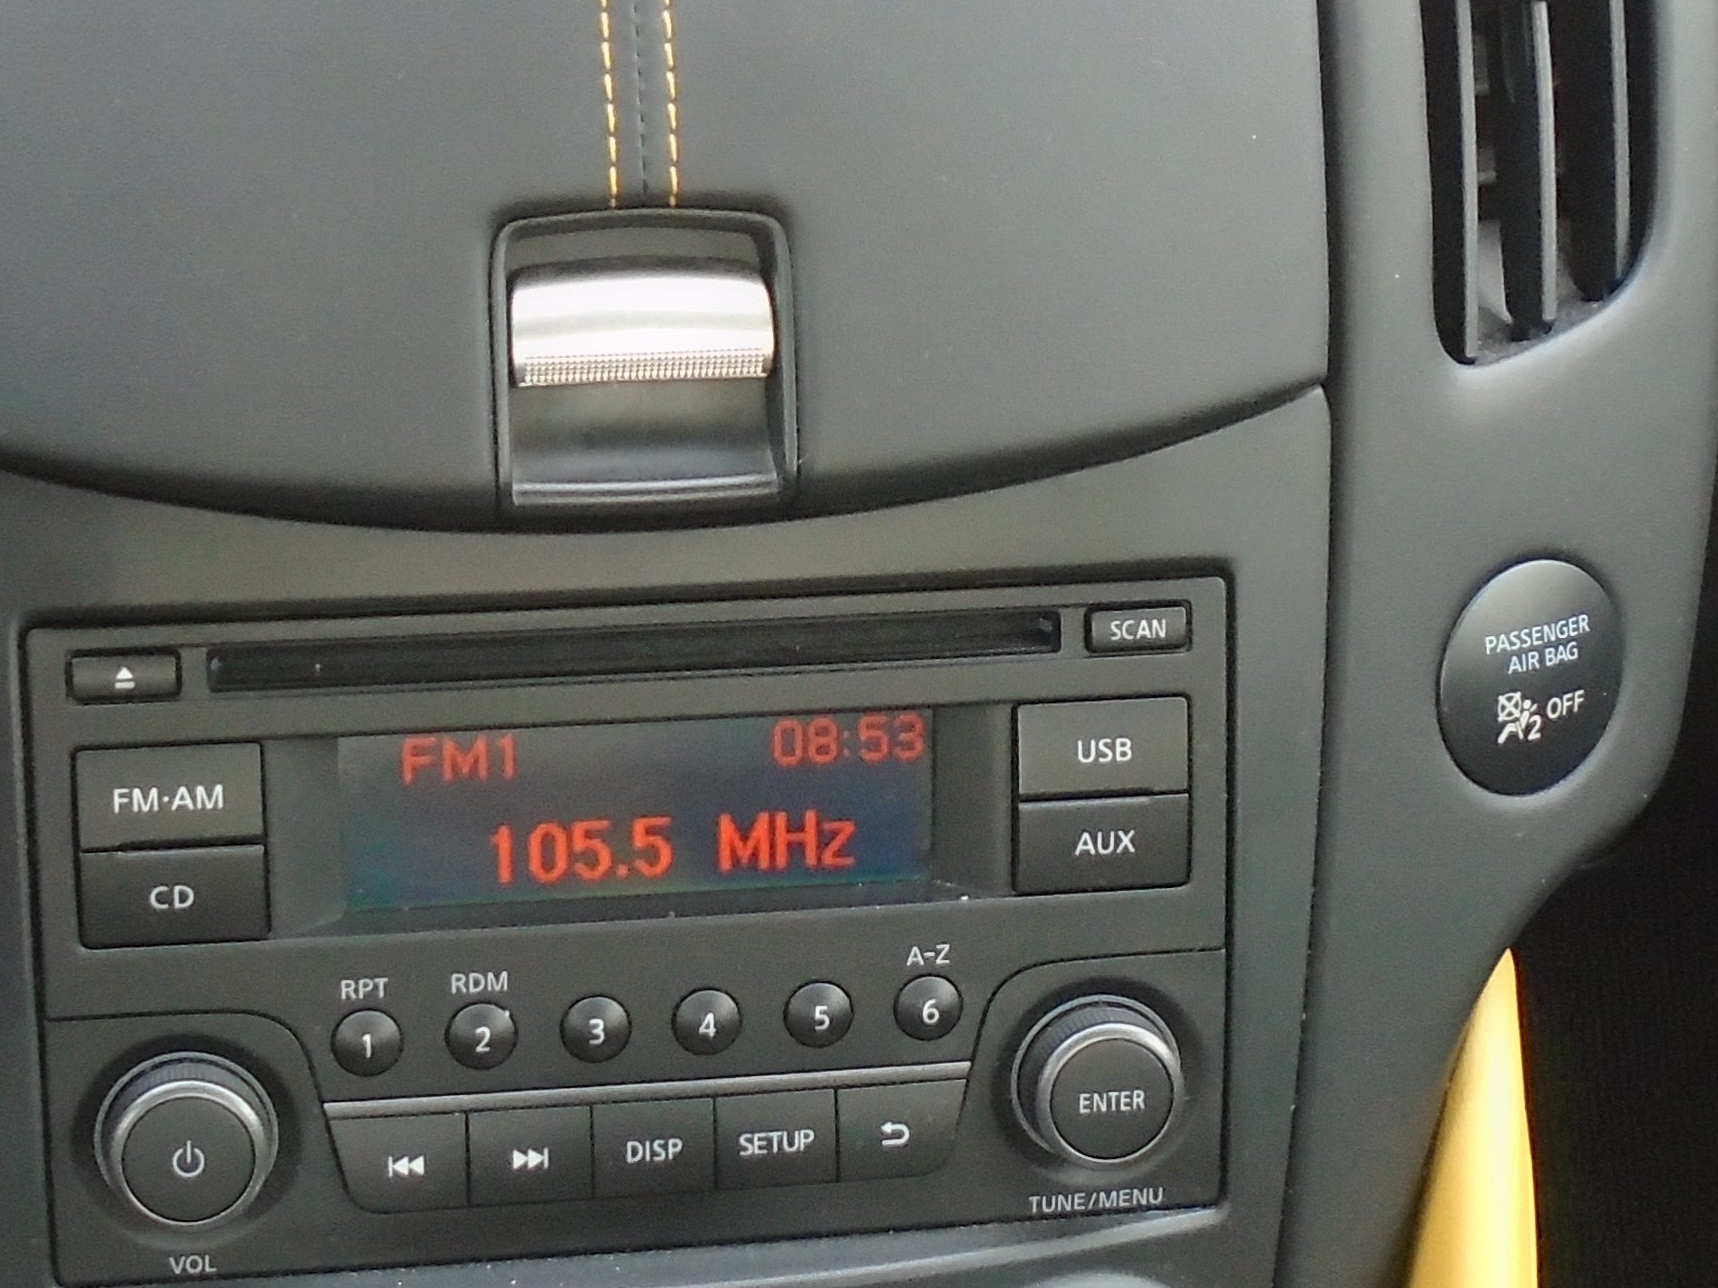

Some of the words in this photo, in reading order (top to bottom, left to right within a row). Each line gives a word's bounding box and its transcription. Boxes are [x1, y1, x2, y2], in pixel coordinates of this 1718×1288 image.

[1110, 618, 1167, 641] SCAN
[1485, 614, 1590, 654] PASSENGER
[1508, 651, 1540, 674] AIR
[1545, 642, 1579, 667] BAG
[1546, 690, 1585, 720] OFF
[770, 713, 926, 767] 08:53
[1077, 738, 1133, 764] USB
[401, 733, 518, 784] FM1
[491, 815, 674, 885] 105.5
[718, 809, 858, 874] MHz
[1075, 830, 1137, 856] AUX
[149, 884, 195, 910] CD
[906, 943, 951, 967] A-Z
[340, 976, 389, 1000] RPT
[450, 971, 509, 995] RDM
[813, 1005, 830, 1031] 5
[922, 998, 939, 1024] 6
[588, 1019, 605, 1044] 3
[698, 1012, 717, 1039] 4
[361, 1033, 373, 1058] 1
[475, 1027, 491, 1053] 2
[1078, 1089, 1146, 1114] ENTER
[627, 1138, 683, 1164] DISP
[739, 1128, 815, 1157] SETUP
[1028, 1186, 1164, 1214] TUNE/MENU
[169, 1253, 217, 1275] VOL
